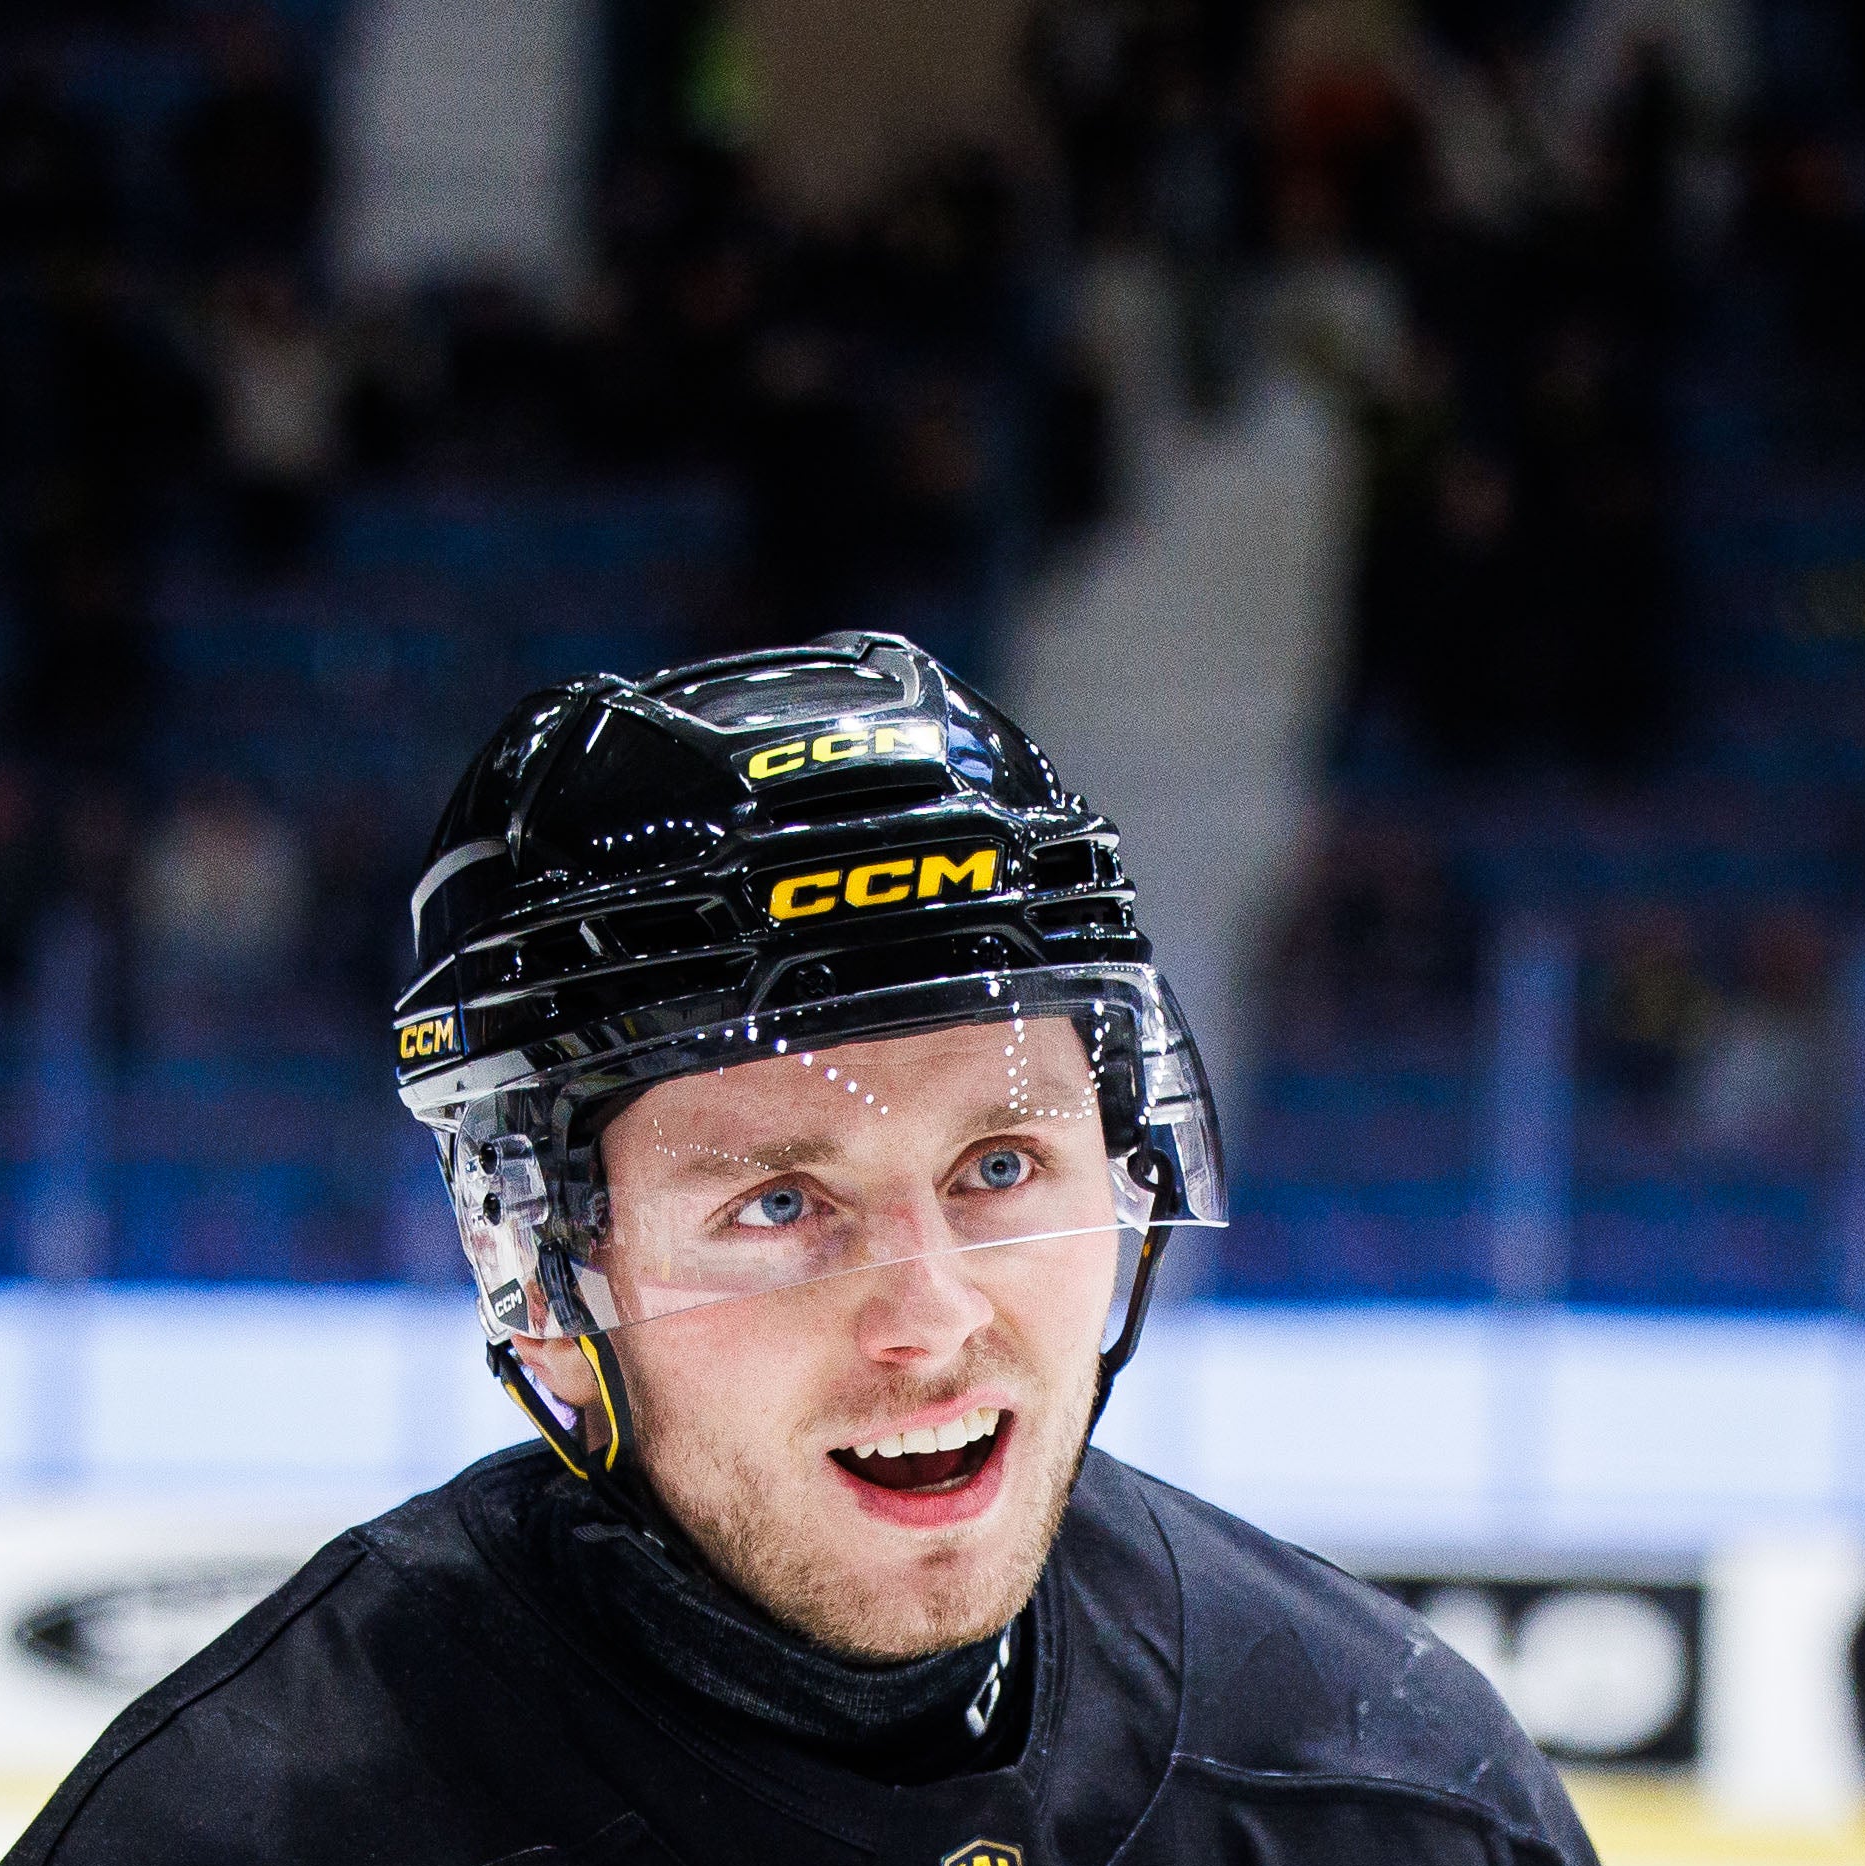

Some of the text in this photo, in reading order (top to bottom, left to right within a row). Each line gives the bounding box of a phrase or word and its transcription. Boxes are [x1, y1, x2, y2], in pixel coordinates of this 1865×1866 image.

[769, 850, 998, 921] CCM
[400, 1016, 455, 1059] CCM
[494, 1289, 523, 1318] CCM
